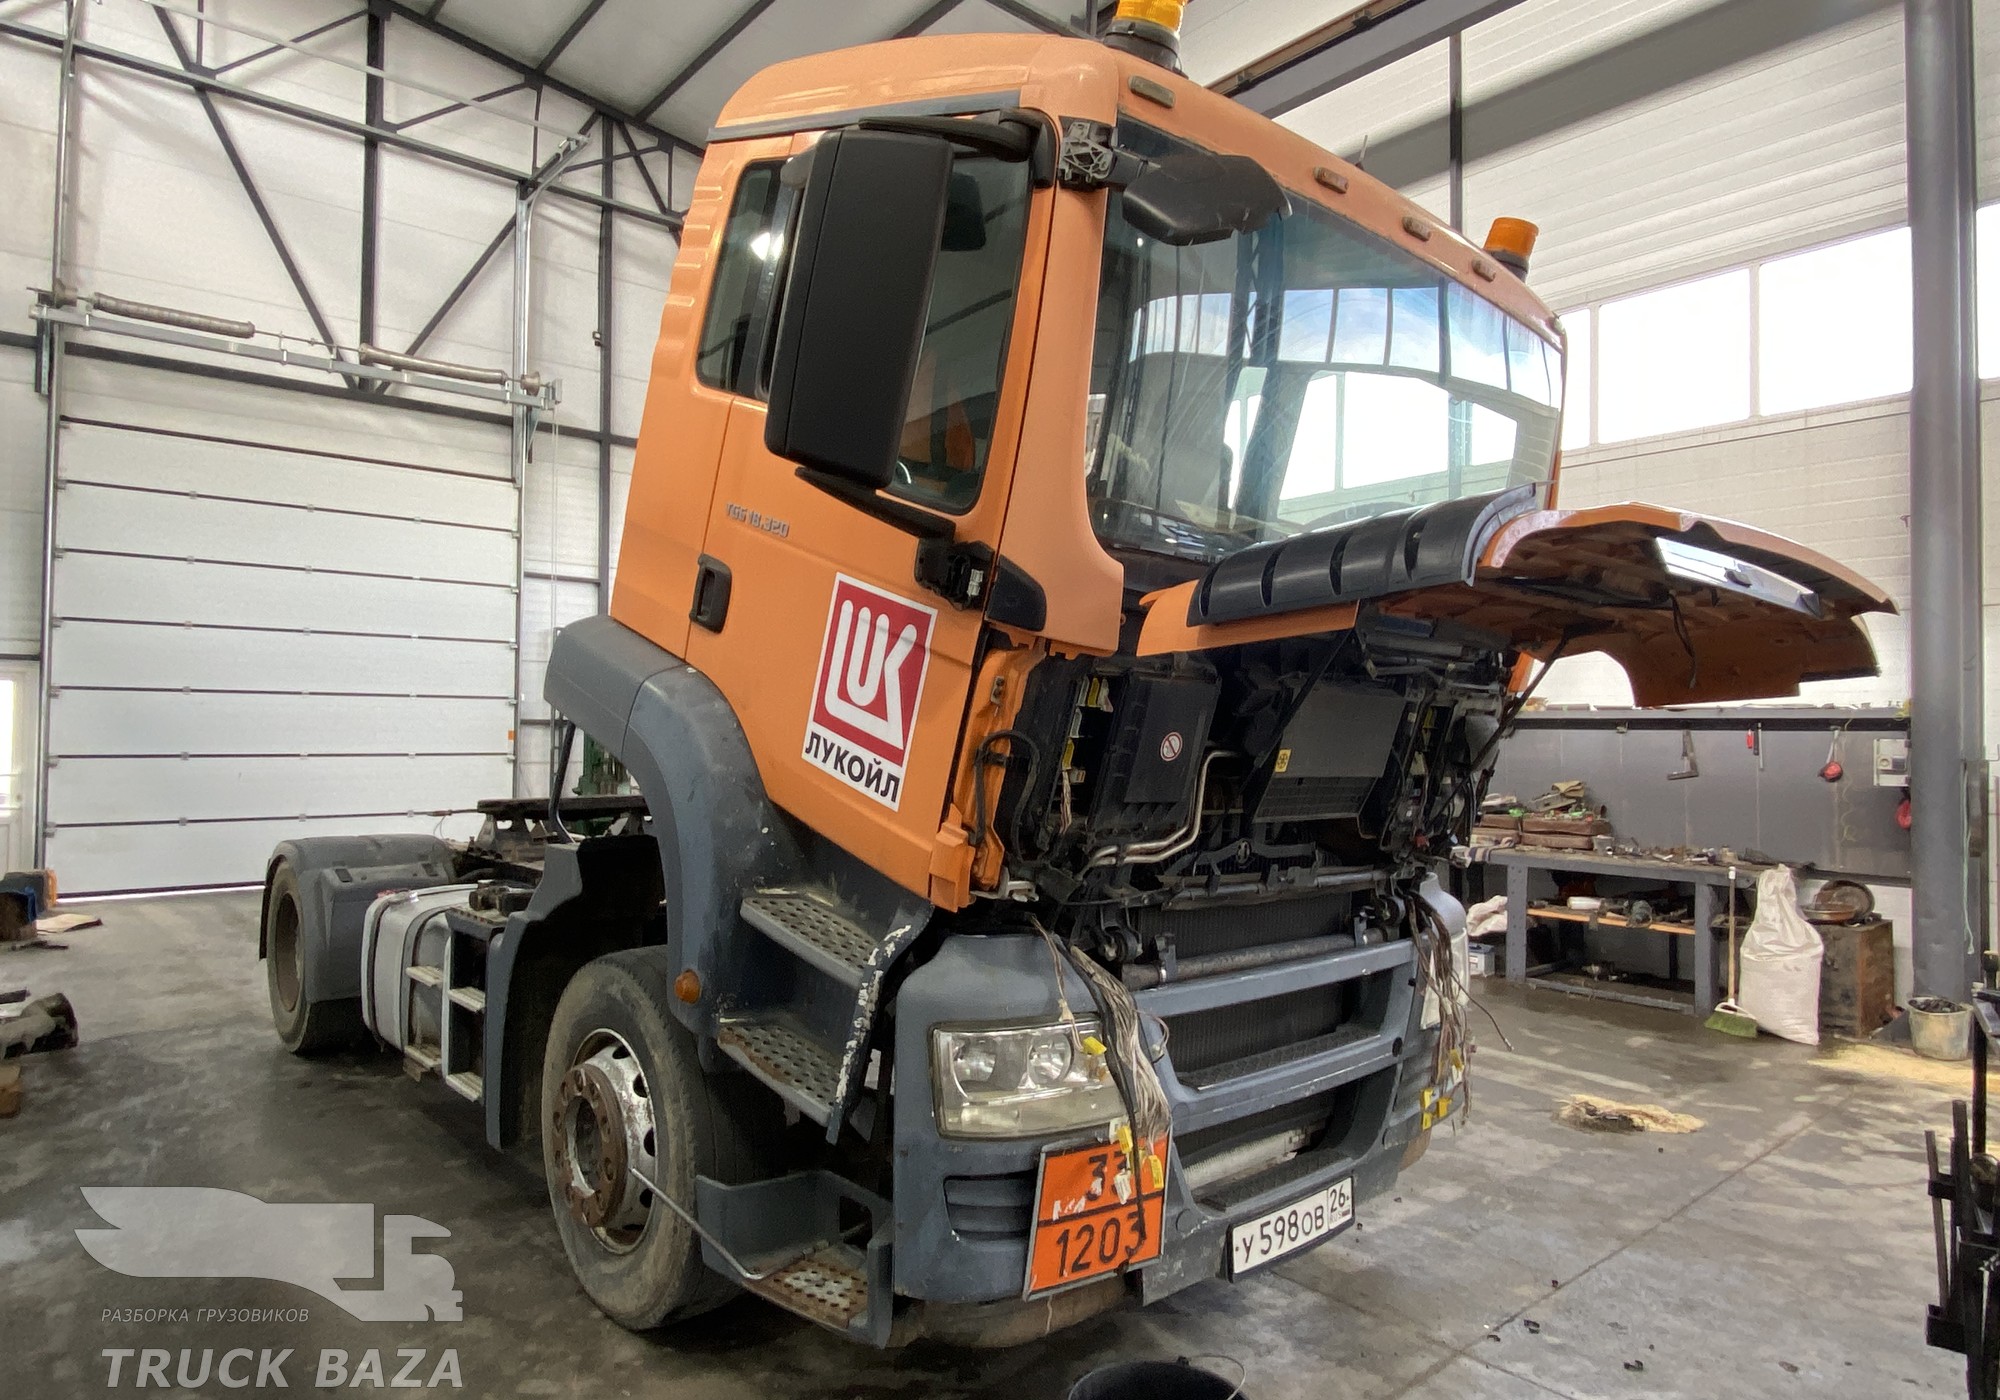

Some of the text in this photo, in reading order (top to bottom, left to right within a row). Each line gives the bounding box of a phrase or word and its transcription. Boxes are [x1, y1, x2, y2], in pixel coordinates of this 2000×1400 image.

[824, 599, 917, 751] LUK
[805, 731, 901, 803] ЛУКОЙЛ
[1329, 1184, 1346, 1213] 26
[1056, 1211, 1145, 1278] 1203
